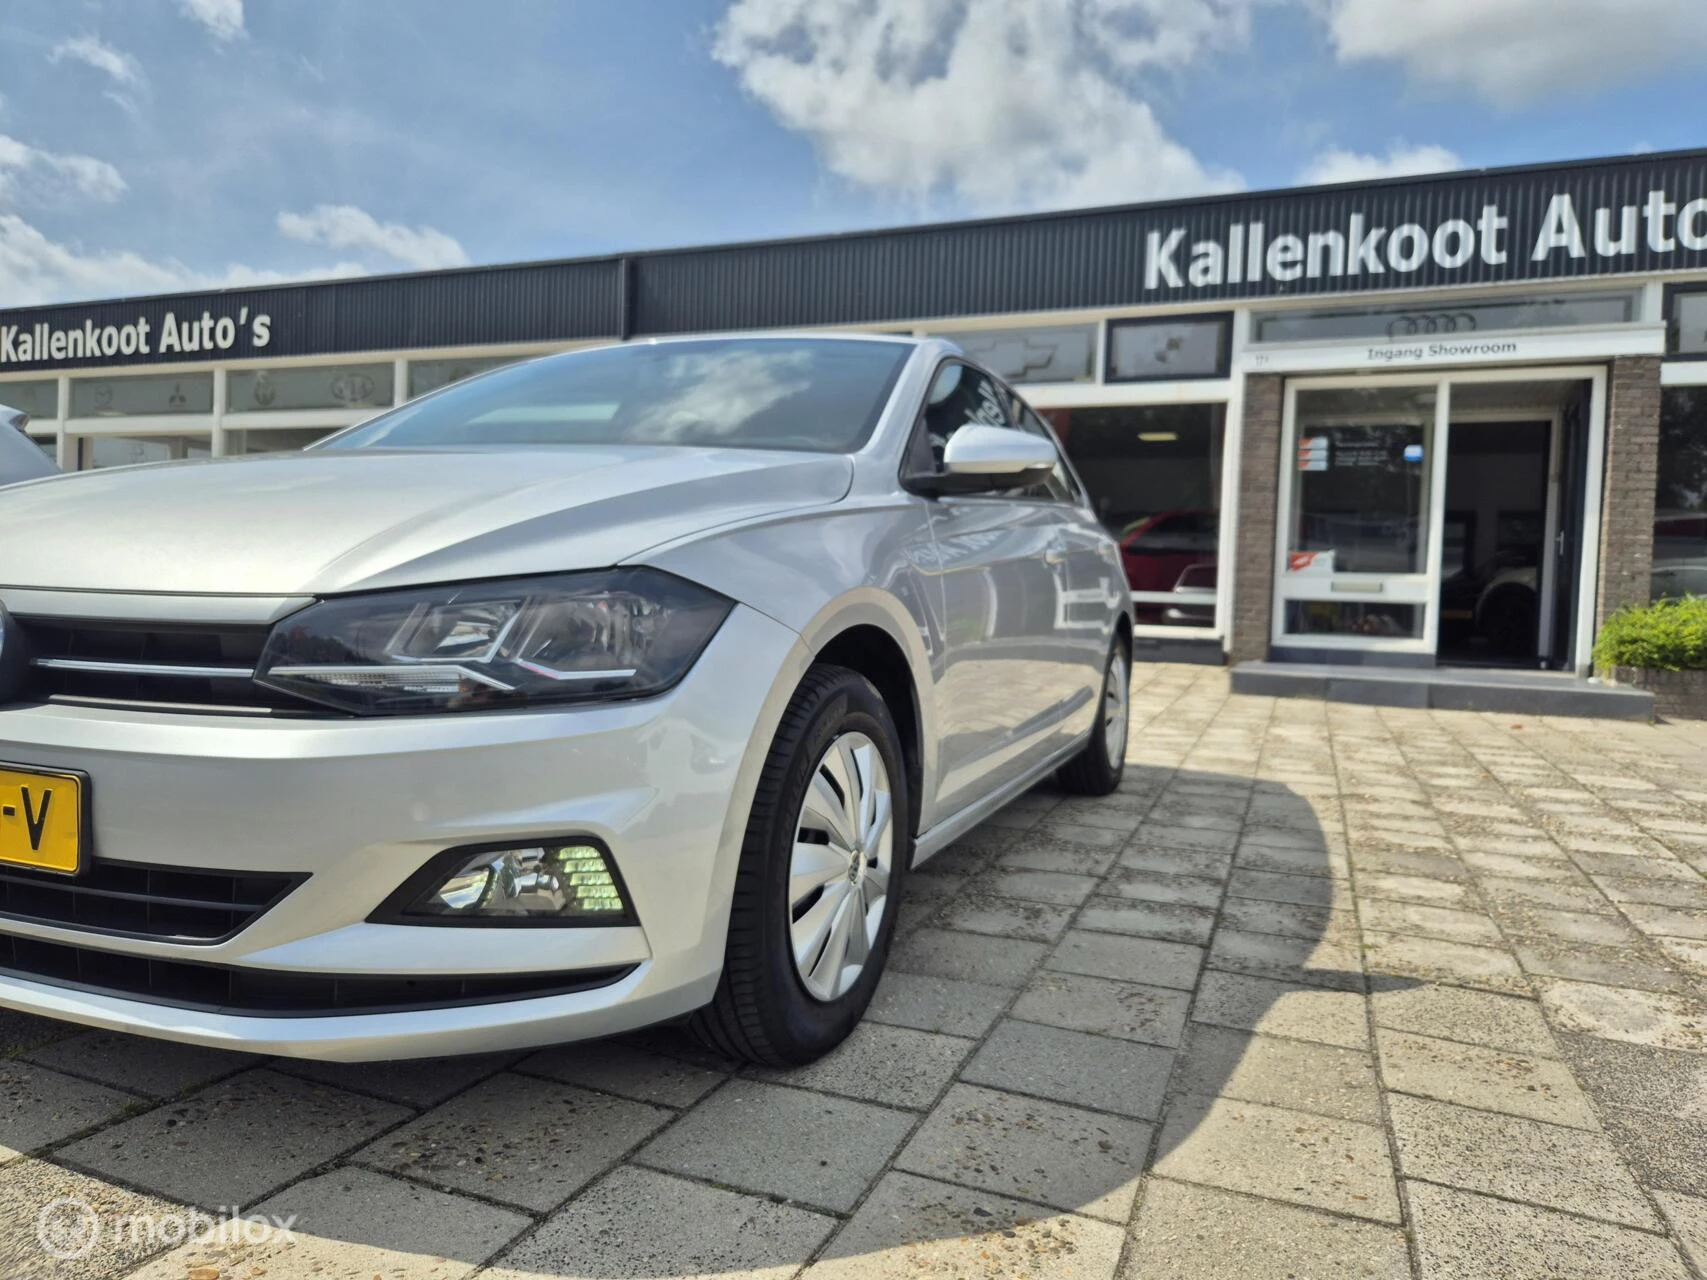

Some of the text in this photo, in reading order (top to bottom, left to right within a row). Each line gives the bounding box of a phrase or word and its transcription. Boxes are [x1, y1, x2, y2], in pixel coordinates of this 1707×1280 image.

[1144, 189, 1707, 291] Kallenkoot Auto
[0, 306, 271, 363] Kallenkoot Auto's
[1367, 342, 1517, 362] Ingang Showroom
